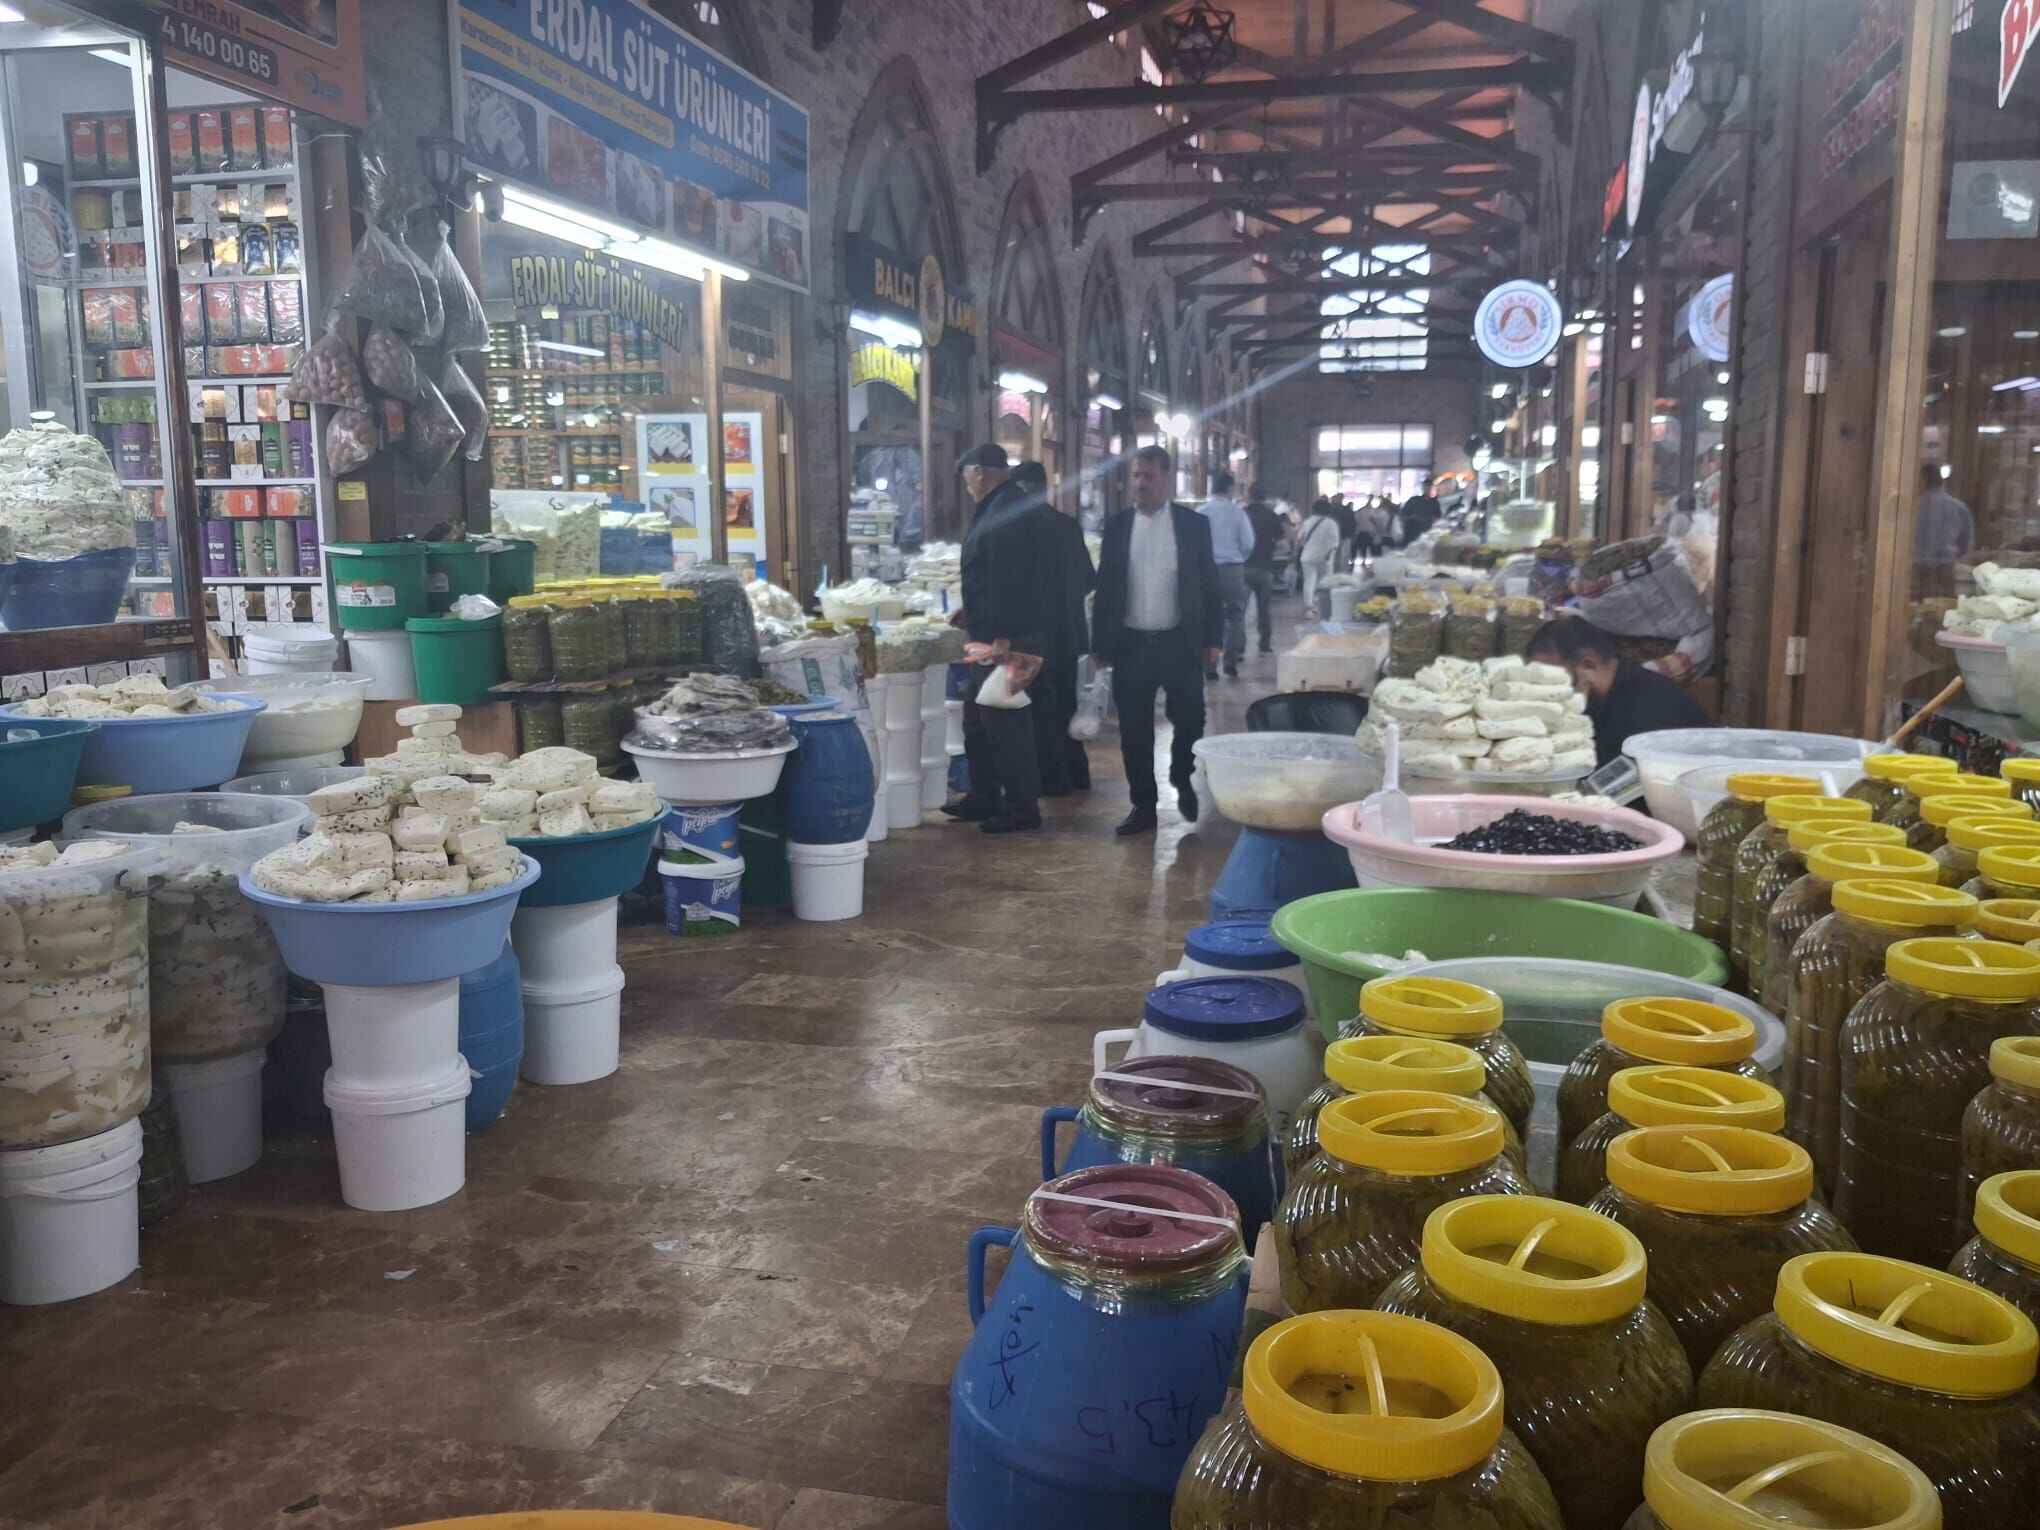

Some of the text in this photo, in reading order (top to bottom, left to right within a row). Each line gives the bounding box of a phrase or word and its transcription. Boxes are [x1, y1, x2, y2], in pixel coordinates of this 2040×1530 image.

[182, 0, 241, 33] EMRAH
[181, 22, 216, 57] 140
[220, 38, 244, 68] 00
[248, 48, 271, 79] 65
[529, 0, 771, 165] ERDAL SÜT ÜRÜNLERİ
[511, 255, 572, 308] ERDAL
[573, 249, 607, 310] SÜT
[609, 259, 684, 353] ÜRÜNLERİ
[875, 257, 915, 310] BALCI
